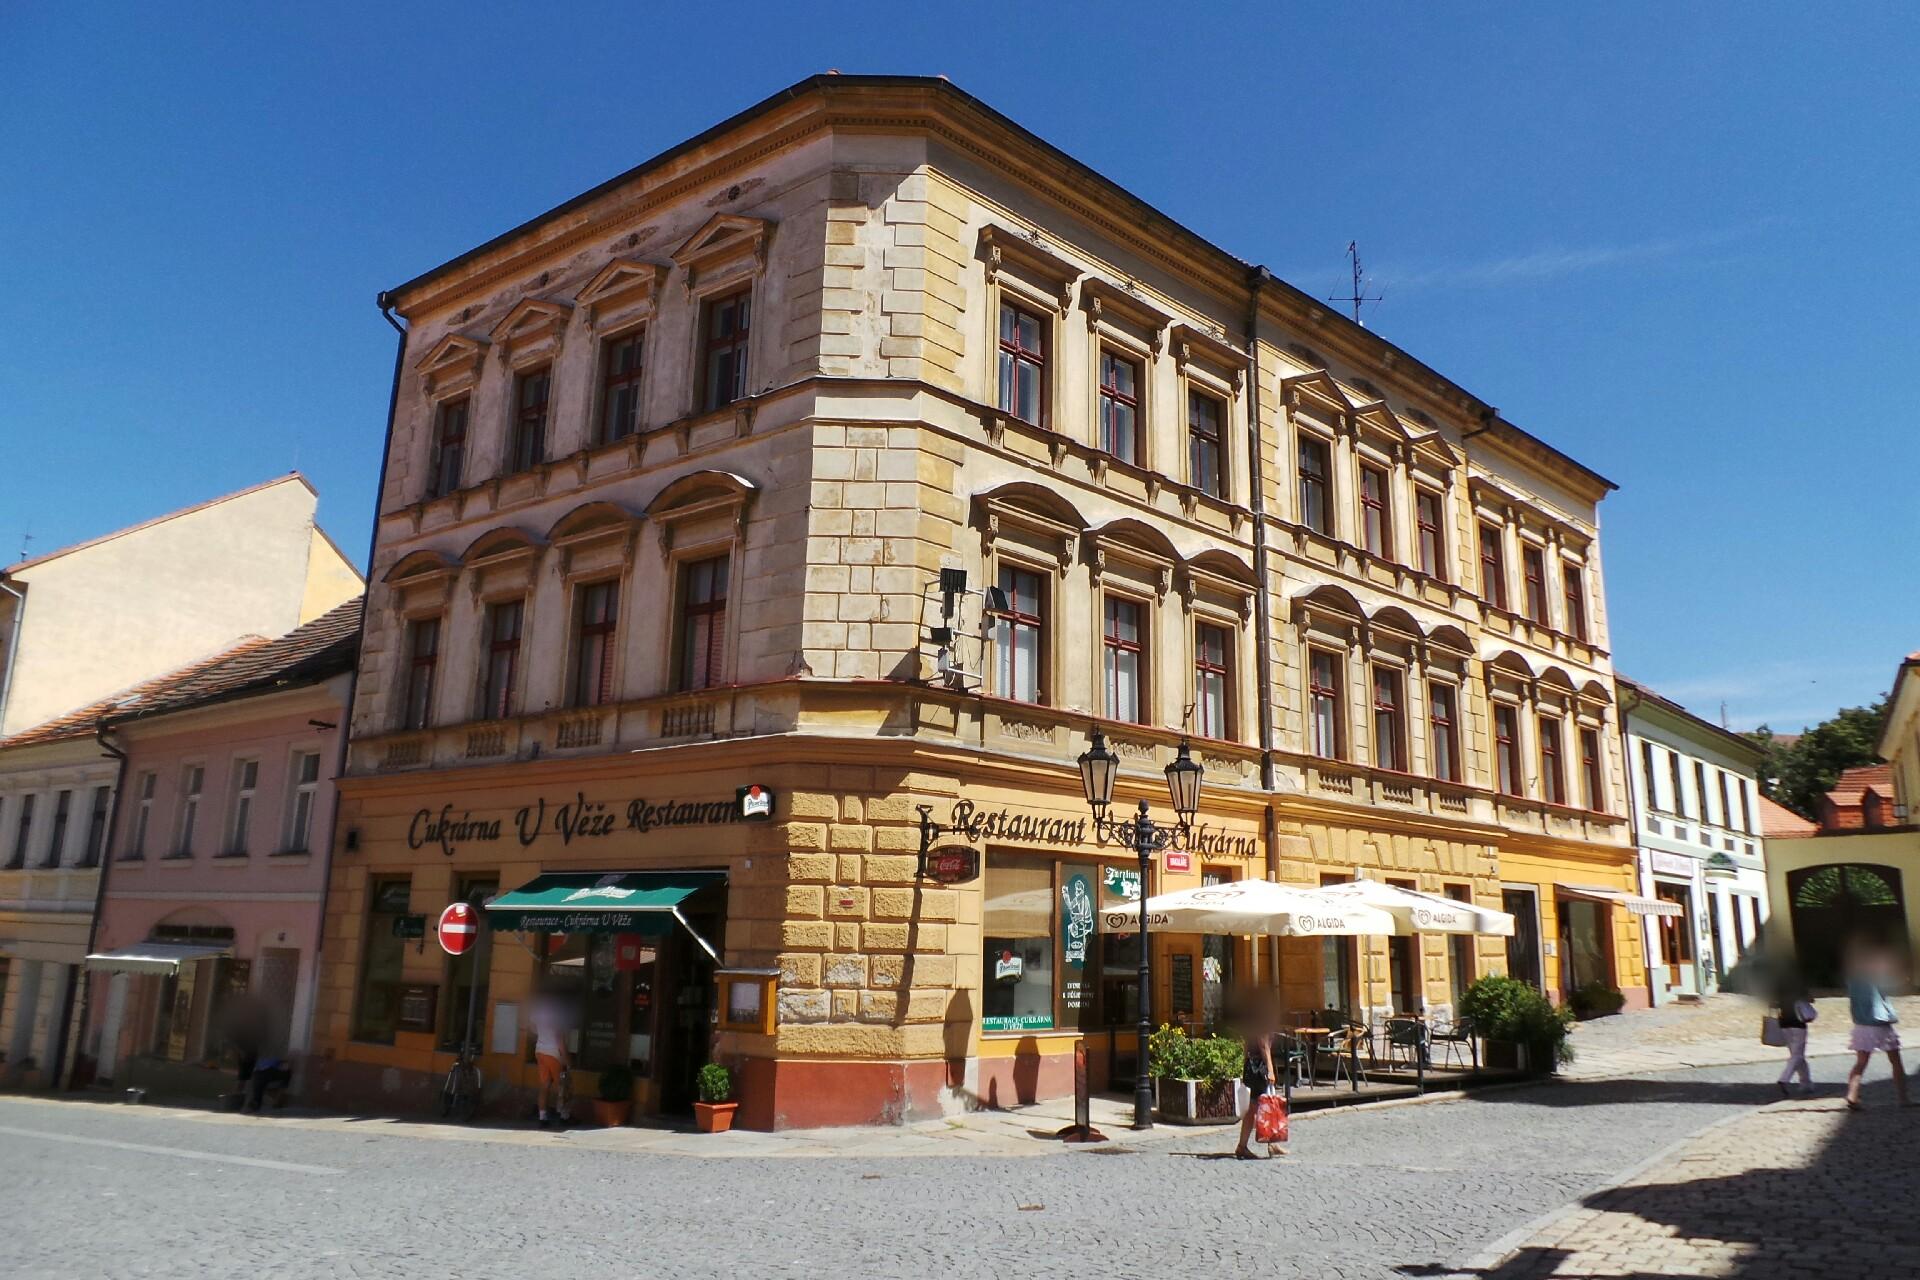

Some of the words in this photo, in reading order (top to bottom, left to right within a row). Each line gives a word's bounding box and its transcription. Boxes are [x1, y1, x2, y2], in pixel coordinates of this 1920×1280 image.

[407, 803, 501, 856] Cukrárna
[514, 798, 544, 847] U
[555, 792, 616, 847] Věže
[626, 798, 737, 833] Restauran
[951, 799, 1088, 846] Restaurant
[602, 912, 611, 926] U
[1317, 917, 1346, 929] ALGIDA
[1432, 913, 1457, 924] ALGIDA
